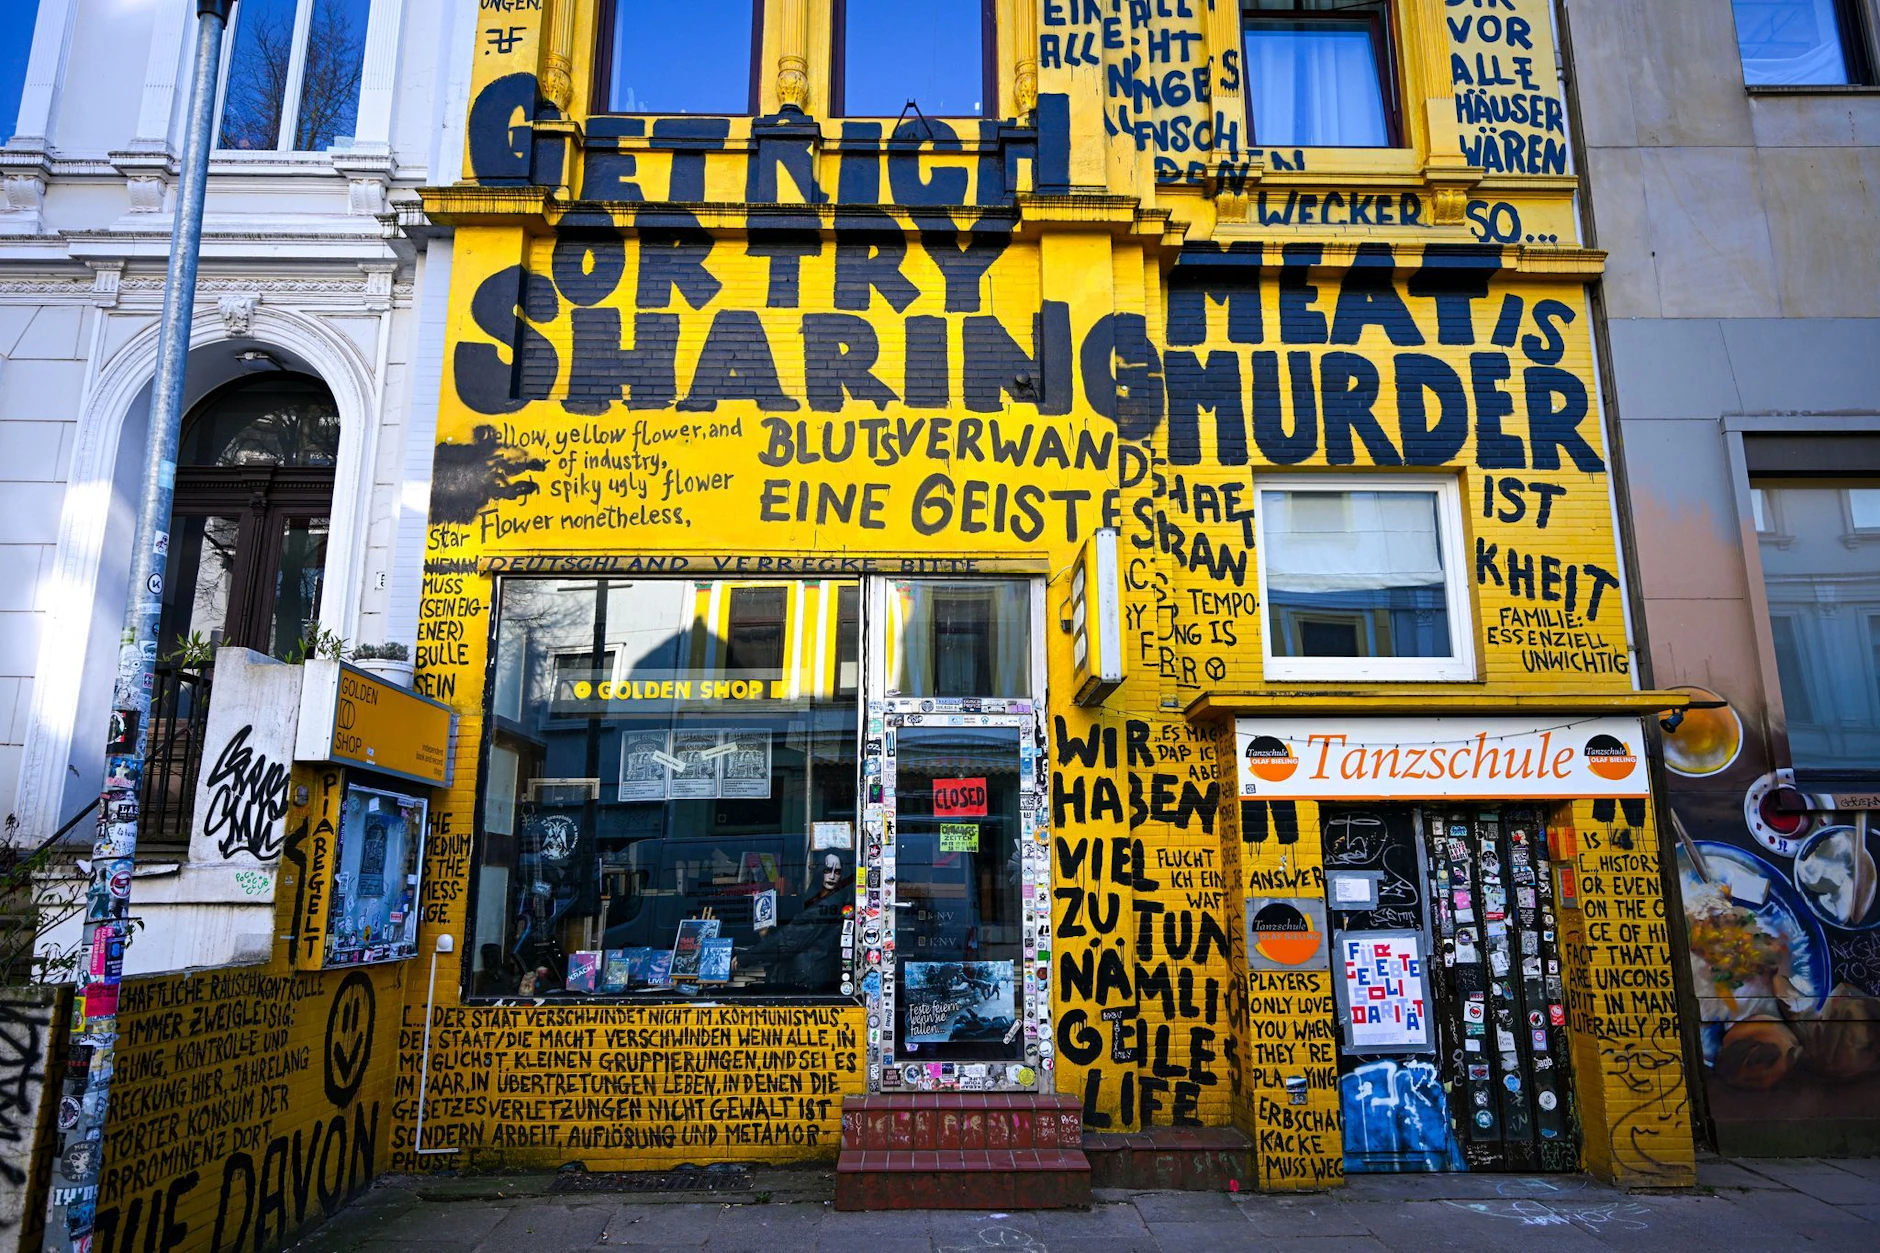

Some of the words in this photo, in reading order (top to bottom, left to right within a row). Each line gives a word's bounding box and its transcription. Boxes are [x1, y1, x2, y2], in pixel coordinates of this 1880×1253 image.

[1447, 15, 1533, 50] VOR
[1455, 88, 1565, 139] HÄUSER
[1459, 126, 1567, 175] WÄREN
[1258, 189, 1427, 228] WECKER
[552, 204, 724, 309] OR
[744, 204, 1022, 314] TRY
[1165, 241, 1500, 346] MEAT
[1490, 292, 1577, 366] IS
[453, 262, 1167, 438] SHARING
[1163, 349, 1607, 473] MURDER
[555, 422, 627, 455] yellow
[558, 450, 577, 476] of
[583, 447, 668, 476] industry,
[550, 472, 602, 505] spiky
[607, 471, 648, 499] ugly
[660, 472, 735, 501] flower
[1483, 475, 1568, 530] IST
[427, 528, 471, 552] Star
[476, 506, 553, 545] Flower
[559, 504, 692, 530] nonetheless,
[486, 556, 689, 571] DEUTSCHLAND
[899, 556, 981, 573] BITTE
[759, 482, 895, 528] EINE
[1475, 536, 1621, 622] KHEIT
[421, 577, 464, 596] MUSS
[417, 619, 465, 643] ENER)
[1499, 606, 1585, 630] FAMILIE:
[1486, 626, 1611, 650] ESSENZIELL
[415, 641, 469, 670] BULLE
[1521, 649, 1630, 676] UNWICHTIG
[341, 676, 379, 706] GOLDEN
[413, 672, 457, 700] SEIN
[597, 680, 691, 701] GOLDEN
[699, 679, 764, 700] SHOP
[335, 731, 362, 755] SHOP
[1053, 714, 1156, 769] WIR
[1247, 747, 1290, 759] Tanzschule
[1585, 746, 1627, 758] Tanzschule
[1271, 757, 1299, 765] BIELING
[1307, 730, 1575, 781] Tanzschule
[1591, 755, 1611, 764] OLAF
[1612, 755, 1637, 764] BIELING
[935, 786, 985, 810] CLOSED
[1052, 770, 1222, 836] HABEN
[1583, 831, 1602, 851] IS
[436, 855, 466, 880] THE
[1056, 836, 1161, 893] VIEL
[1156, 848, 1216, 869] FLUCHT
[1170, 870, 1194, 889] ICH
[1250, 865, 1326, 892] ANSWER
[1581, 876, 1606, 897] OR
[1613, 876, 1661, 897] EVEN
[1053, 886, 1121, 940] ZU
[1584, 898, 1608, 920] ON
[1613, 898, 1648, 921] THE
[1132, 896, 1233, 971] TUN
[1254, 917, 1308, 933] Tanzschule
[1282, 932, 1320, 942] BIELING
[1588, 921, 1613, 944] CE
[1618, 922, 1642, 945] OF
[1348, 942, 1392, 967] FÜR
[1565, 942, 1599, 966] FACT
[1605, 944, 1654, 967] THAT
[209, 970, 326, 1002] RAUSCHKONTROLLE
[567, 964, 594, 982] KRACH
[1249, 972, 1322, 994] PLAYERS
[1569, 966, 1593, 991] ARE
[909, 1002, 932, 1015] Feste
[931, 999, 960, 1014] feiern
[1250, 998, 1293, 1016] ONLY
[1299, 996, 1334, 1016] LOVE
[1603, 992, 1625, 1015] IN
[127, 1012, 184, 1047] IMMER
[189, 1000, 297, 1037] ZWEIGLEISIG:
[433, 1005, 466, 1028] DER
[470, 1009, 523, 1031] STAAT
[524, 1008, 647, 1028] VERSCHWINDET
[649, 1008, 693, 1027] NICHT
[695, 1008, 713, 1027] IM
[1253, 1019, 1287, 1040] YOU
[1292, 1019, 1336, 1042] WHEN
[1572, 1012, 1648, 1041] LITERALLY
[174, 1029, 259, 1072] KONTROLLE
[263, 1029, 289, 1052] UND
[539, 1028, 597, 1050] MACHT
[604, 1027, 732, 1049] VERSCHWINDEN
[737, 1027, 785, 1047] WENN
[513, 1050, 593, 1070] KLEINEN
[762, 1050, 796, 1073] UND
[799, 1050, 828, 1070] SEI
[834, 1051, 858, 1074] ES
[1254, 1043, 1297, 1065] THEY
[191, 1067, 229, 1104] HIER,
[230, 1045, 310, 1095] JAHRELANG
[394, 1074, 415, 1098] IM
[471, 1070, 490, 1092] IN
[497, 1067, 657, 1096] ÜBERTRETUNGEN
[722, 1073, 740, 1094] IN
[742, 1072, 804, 1094] DENEN
[809, 1071, 841, 1096] DIE
[186, 1091, 256, 1139] KONSUM
[259, 1084, 290, 1119] DER
[647, 1096, 706, 1122] NICHT
[710, 1095, 795, 1122] GEWALT
[799, 1097, 833, 1122] IST
[1082, 1068, 1205, 1129] LIFE
[231, 1119, 273, 1155] DORT.
[390, 1119, 486, 1150] SONDERN
[566, 1122, 677, 1150] AUFLÖSUNG
[681, 1123, 719, 1148] UND
[1259, 1129, 1325, 1156] KACKE
[1265, 1154, 1309, 1182] MUSS
[1310, 1156, 1345, 1180] WEG
